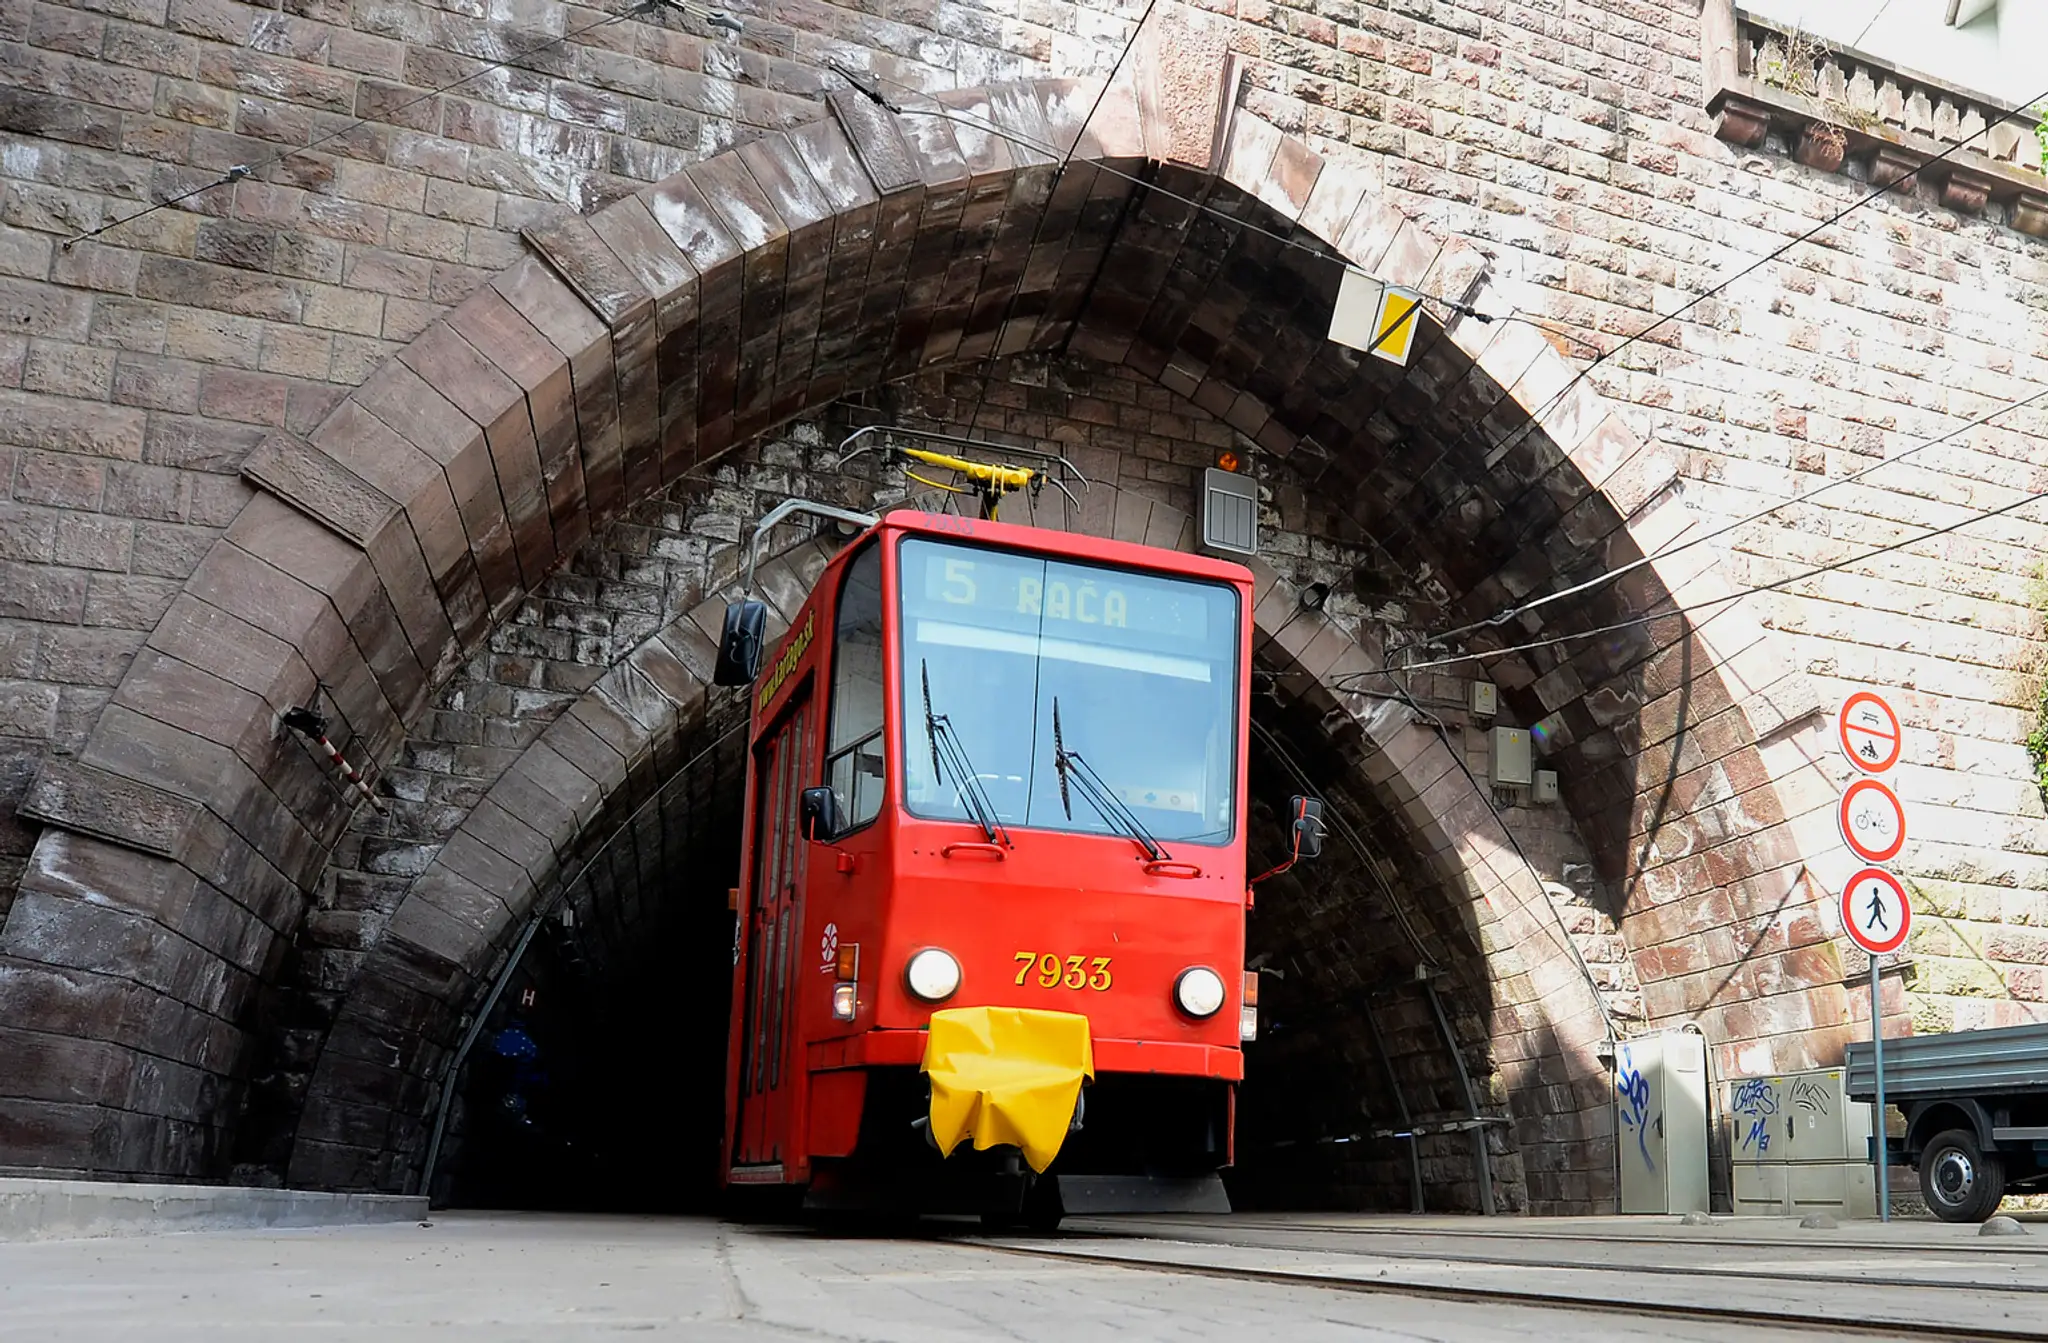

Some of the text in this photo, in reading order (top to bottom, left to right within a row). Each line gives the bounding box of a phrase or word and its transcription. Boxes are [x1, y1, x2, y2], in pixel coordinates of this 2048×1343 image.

[942, 558, 1128, 628] 5 RAČA
[1014, 951, 1113, 991] 7933
[522, 988, 536, 1007] H
